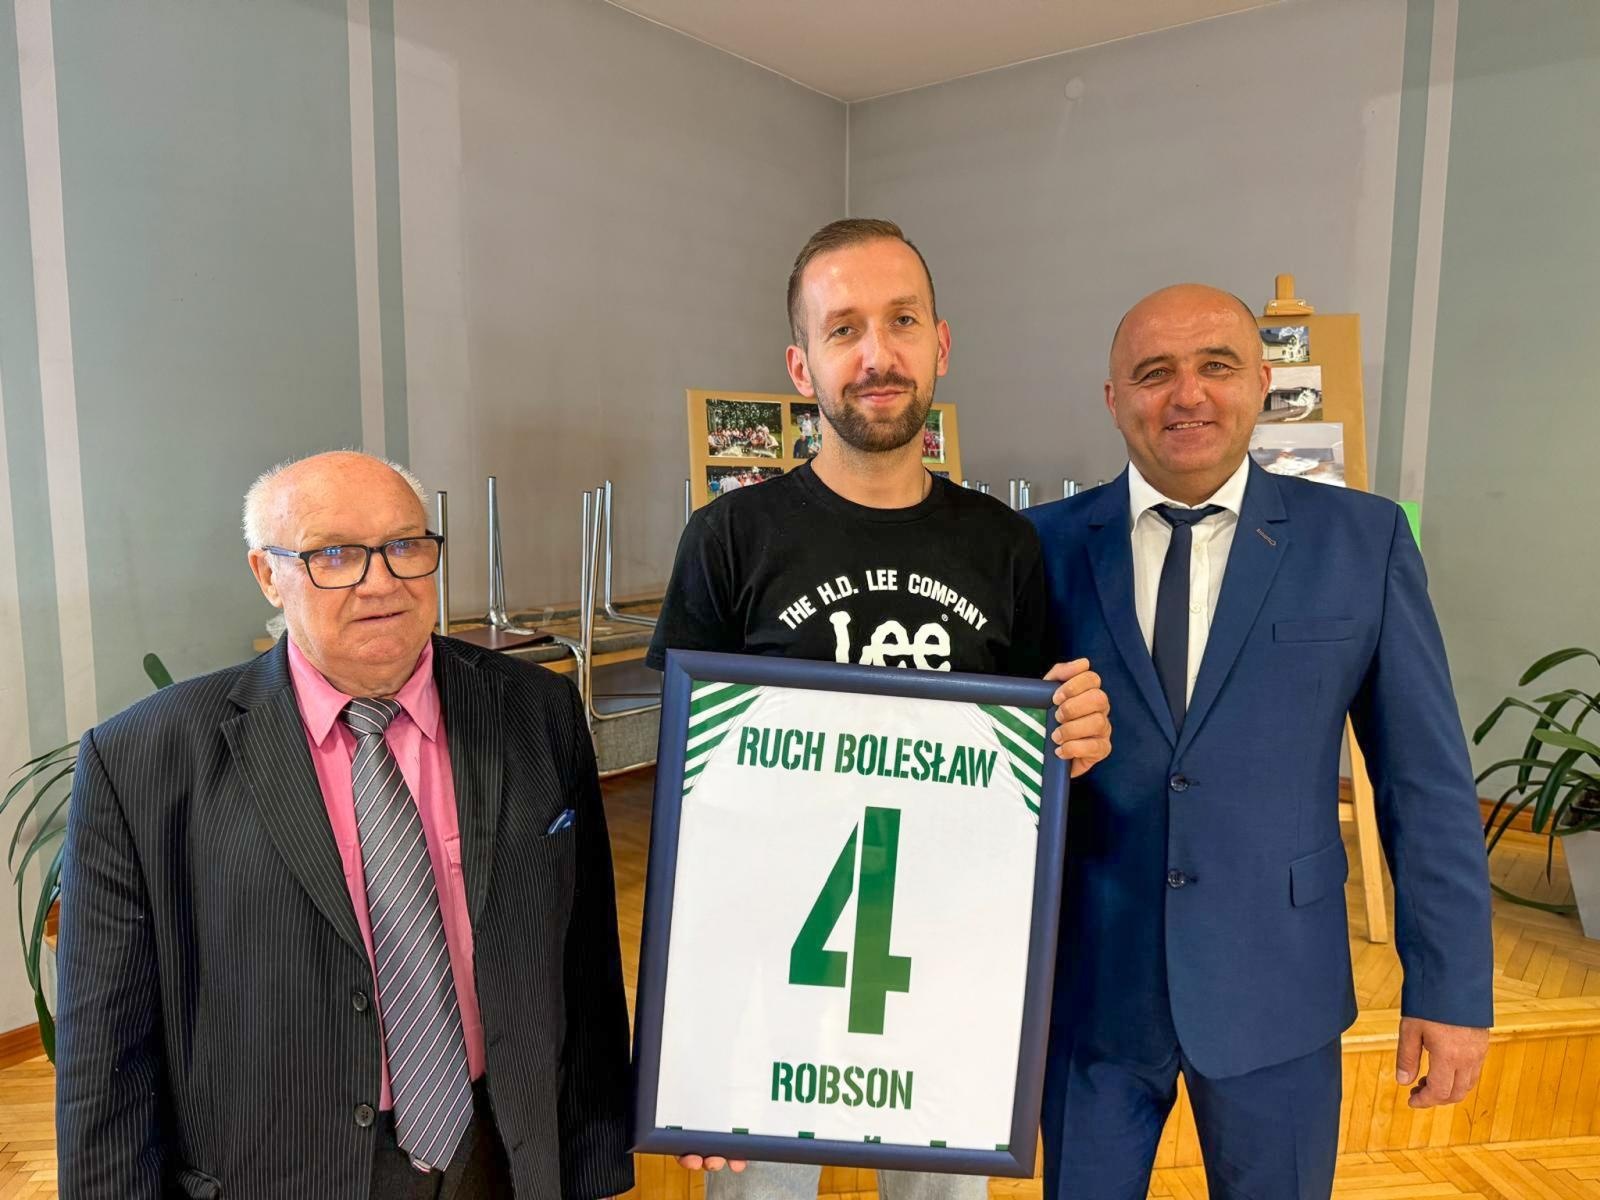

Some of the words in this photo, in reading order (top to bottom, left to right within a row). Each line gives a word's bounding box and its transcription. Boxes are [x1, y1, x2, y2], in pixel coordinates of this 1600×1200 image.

[778, 595, 818, 630] THE
[817, 575, 859, 606] H.D.
[865, 569, 898, 592] LEE
[908, 573, 988, 631] COMPANY
[829, 610, 951, 672] Lee
[736, 726, 826, 771] RUCH
[836, 732, 998, 788] BOLESŁAW
[788, 806, 911, 1035] 4
[771, 1061, 914, 1110] ROBSON
